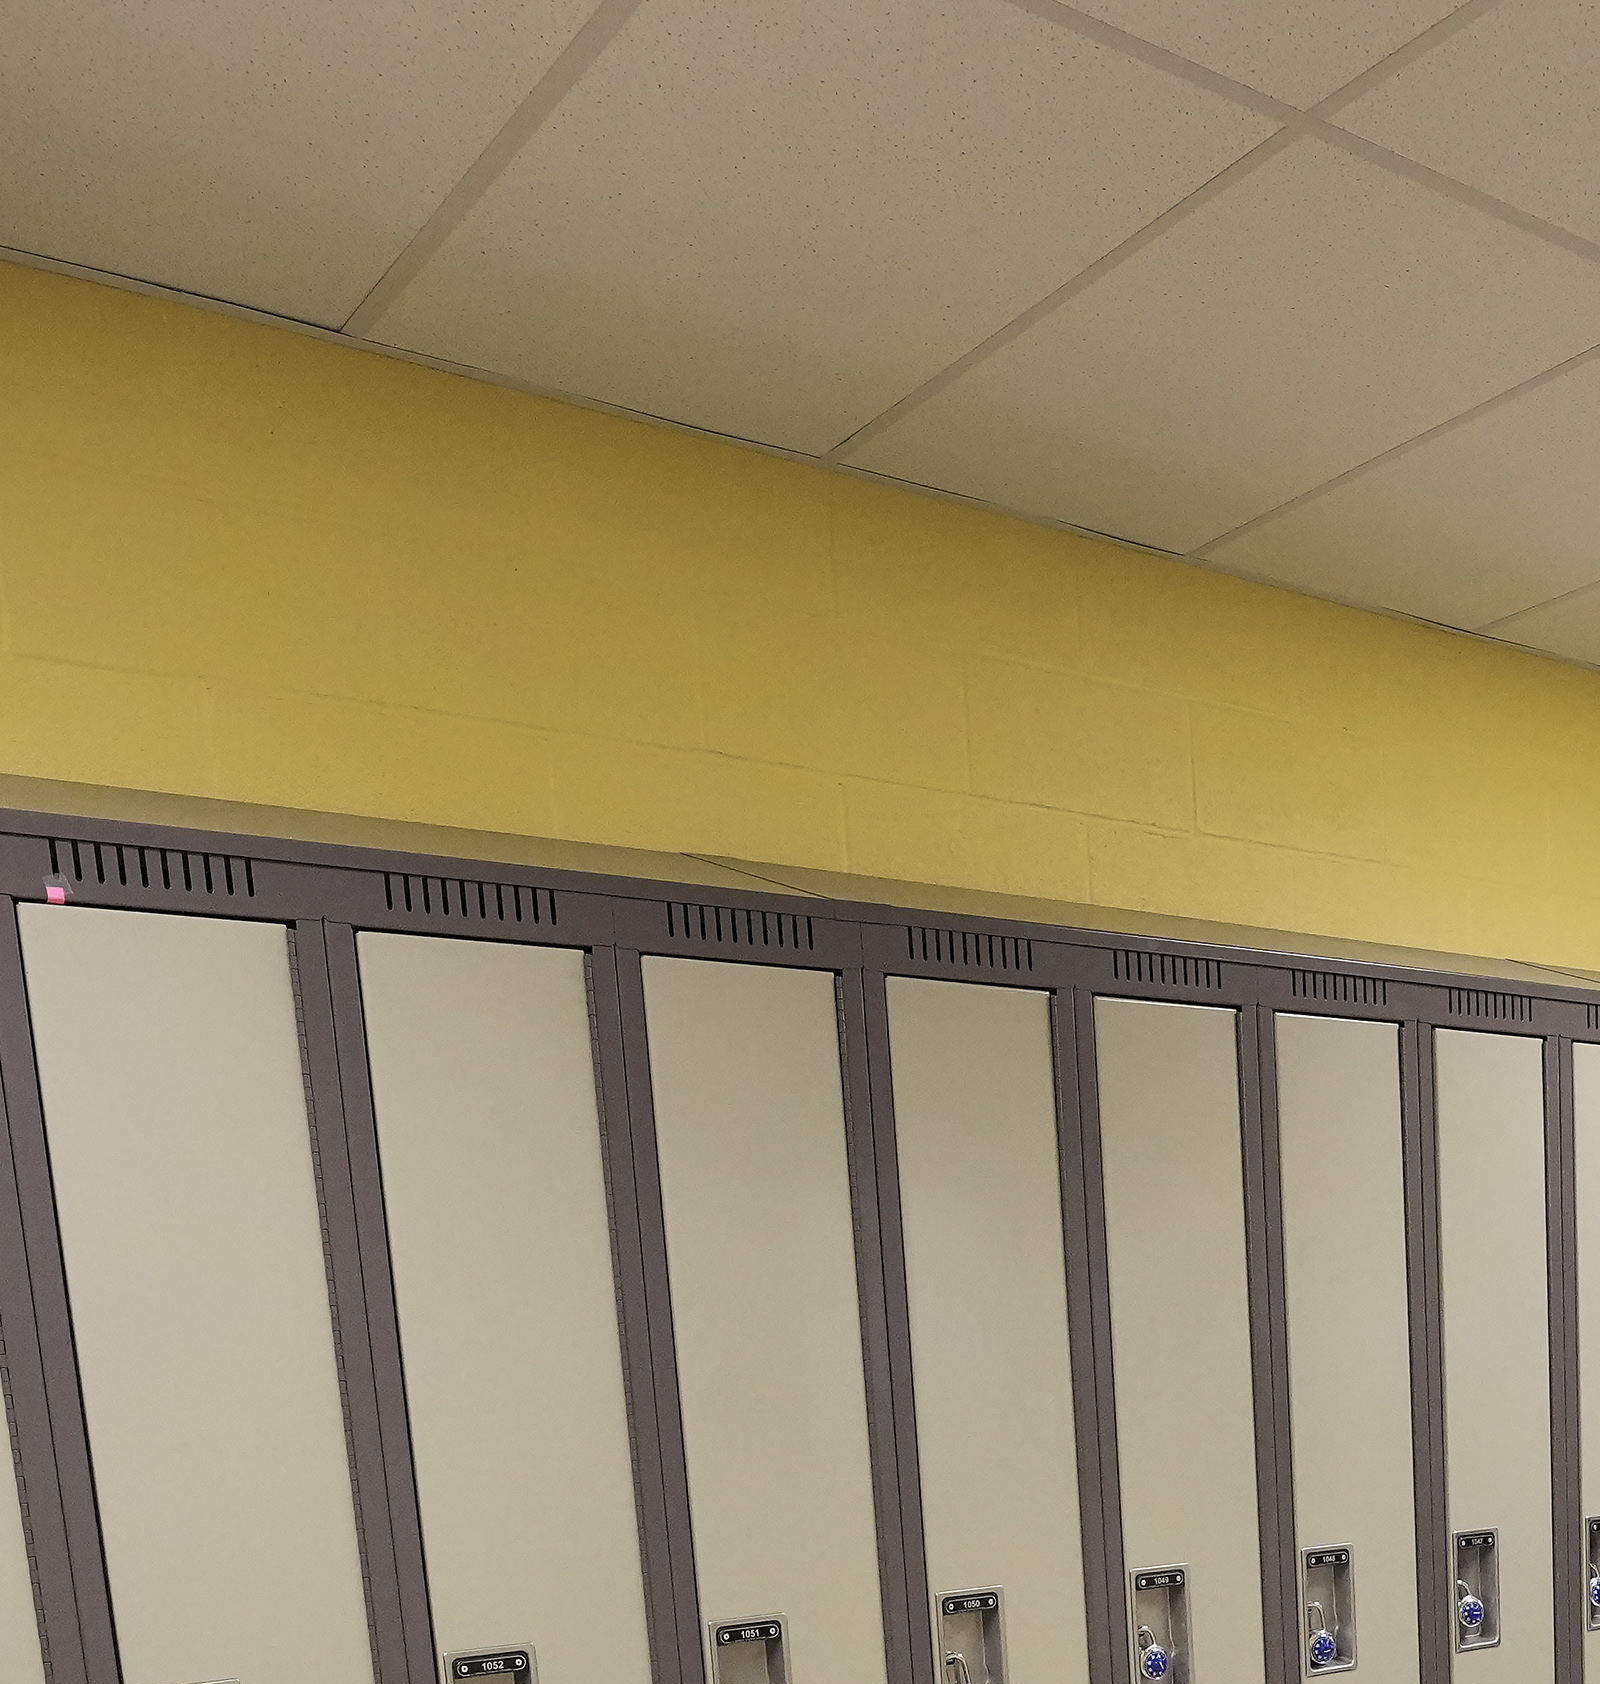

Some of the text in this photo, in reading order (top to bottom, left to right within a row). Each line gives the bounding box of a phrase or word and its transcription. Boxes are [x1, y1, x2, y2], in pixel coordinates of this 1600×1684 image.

[1154, 1576, 1169, 1585] 1049
[963, 1600, 980, 1609] 1050
[741, 1630, 759, 1639] 1051
[482, 1660, 504, 1671] 1052
